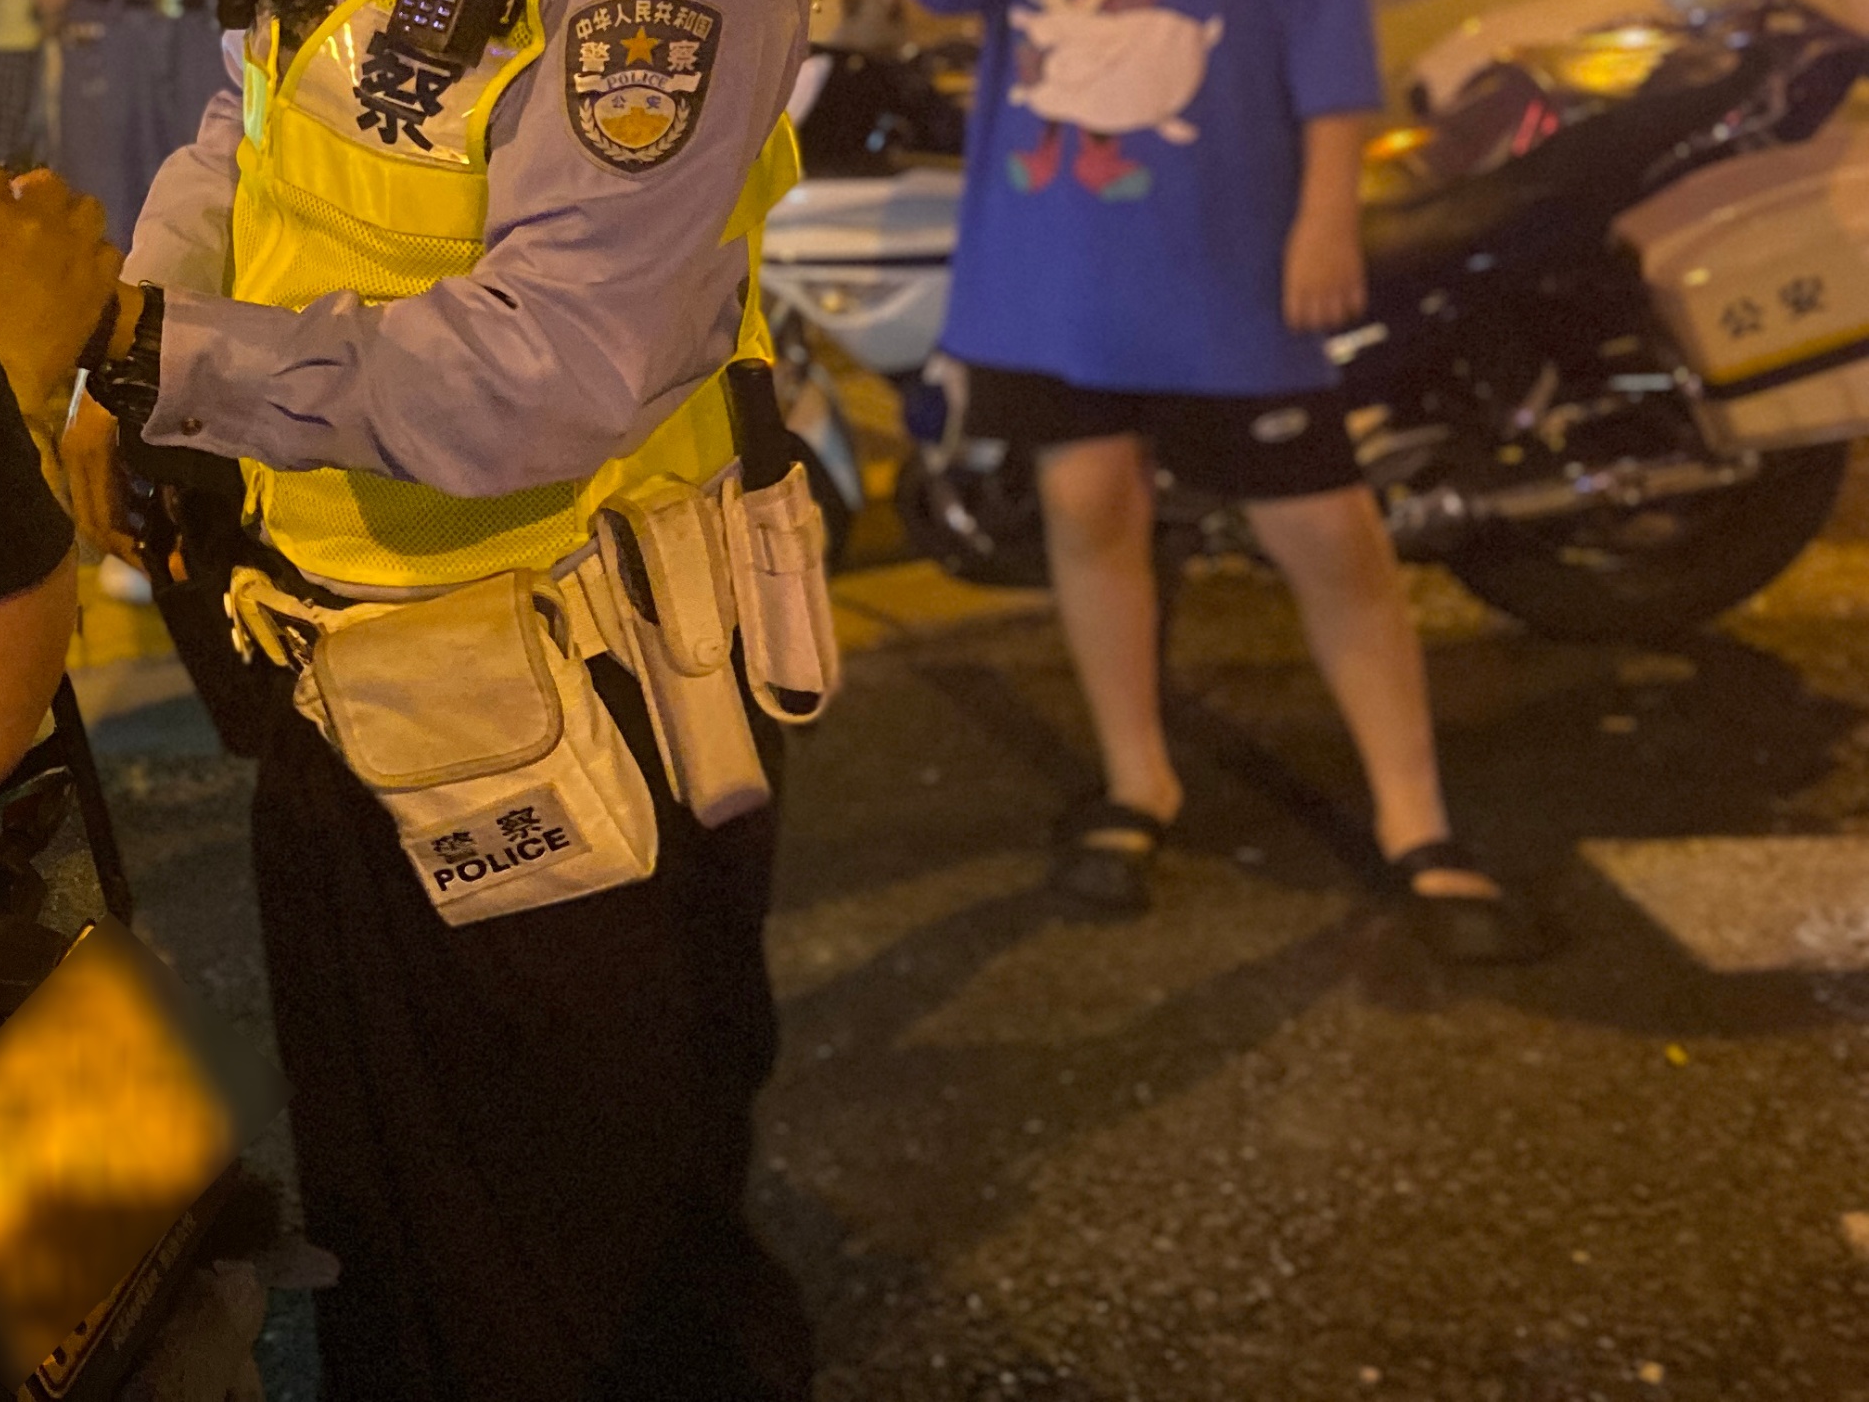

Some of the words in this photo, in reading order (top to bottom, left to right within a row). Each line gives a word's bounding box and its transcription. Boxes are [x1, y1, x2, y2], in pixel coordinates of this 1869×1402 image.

[576, 0, 713, 41] 中华人民共和国
[607, 71, 669, 90] POLICE
[433, 827, 570, 891] POLICE
